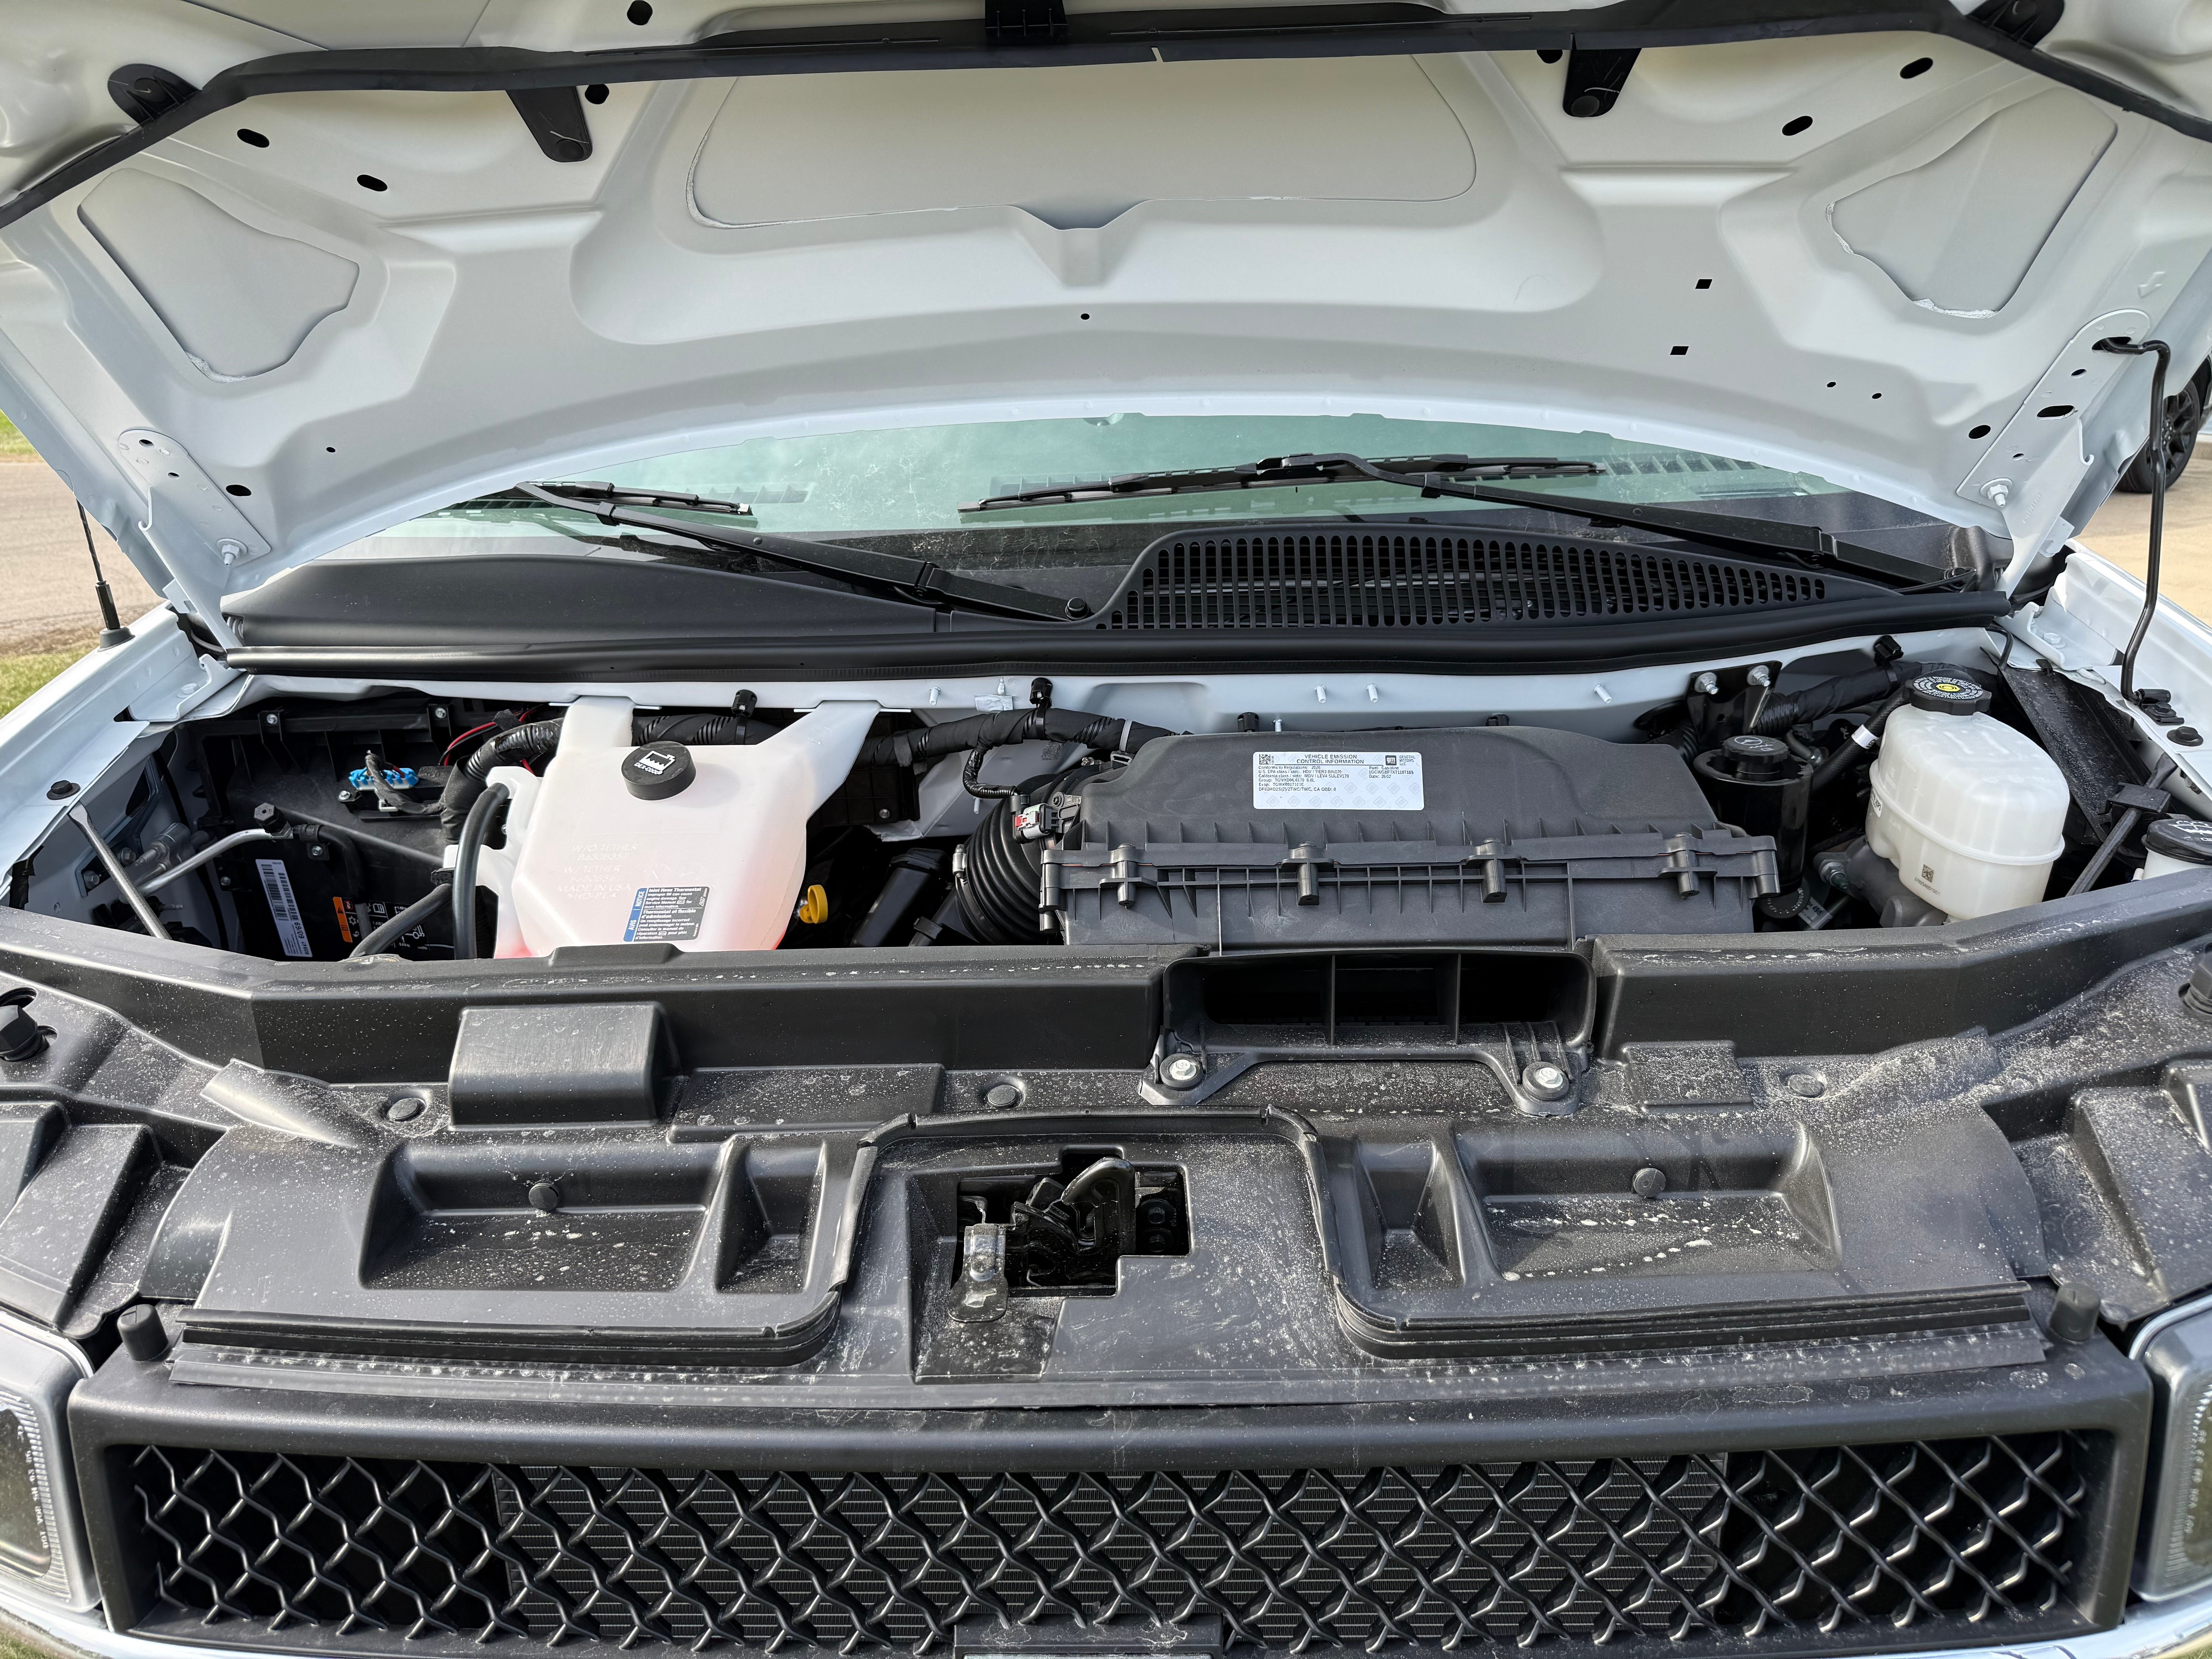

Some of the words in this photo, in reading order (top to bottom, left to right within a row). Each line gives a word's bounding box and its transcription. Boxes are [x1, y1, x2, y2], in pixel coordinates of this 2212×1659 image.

[635, 891, 645, 907] NOTICE
[294, 922, 304, 939] 60/69
[628, 919, 637, 930] AVIS
[40, 1531, 49, 1549] DOT
